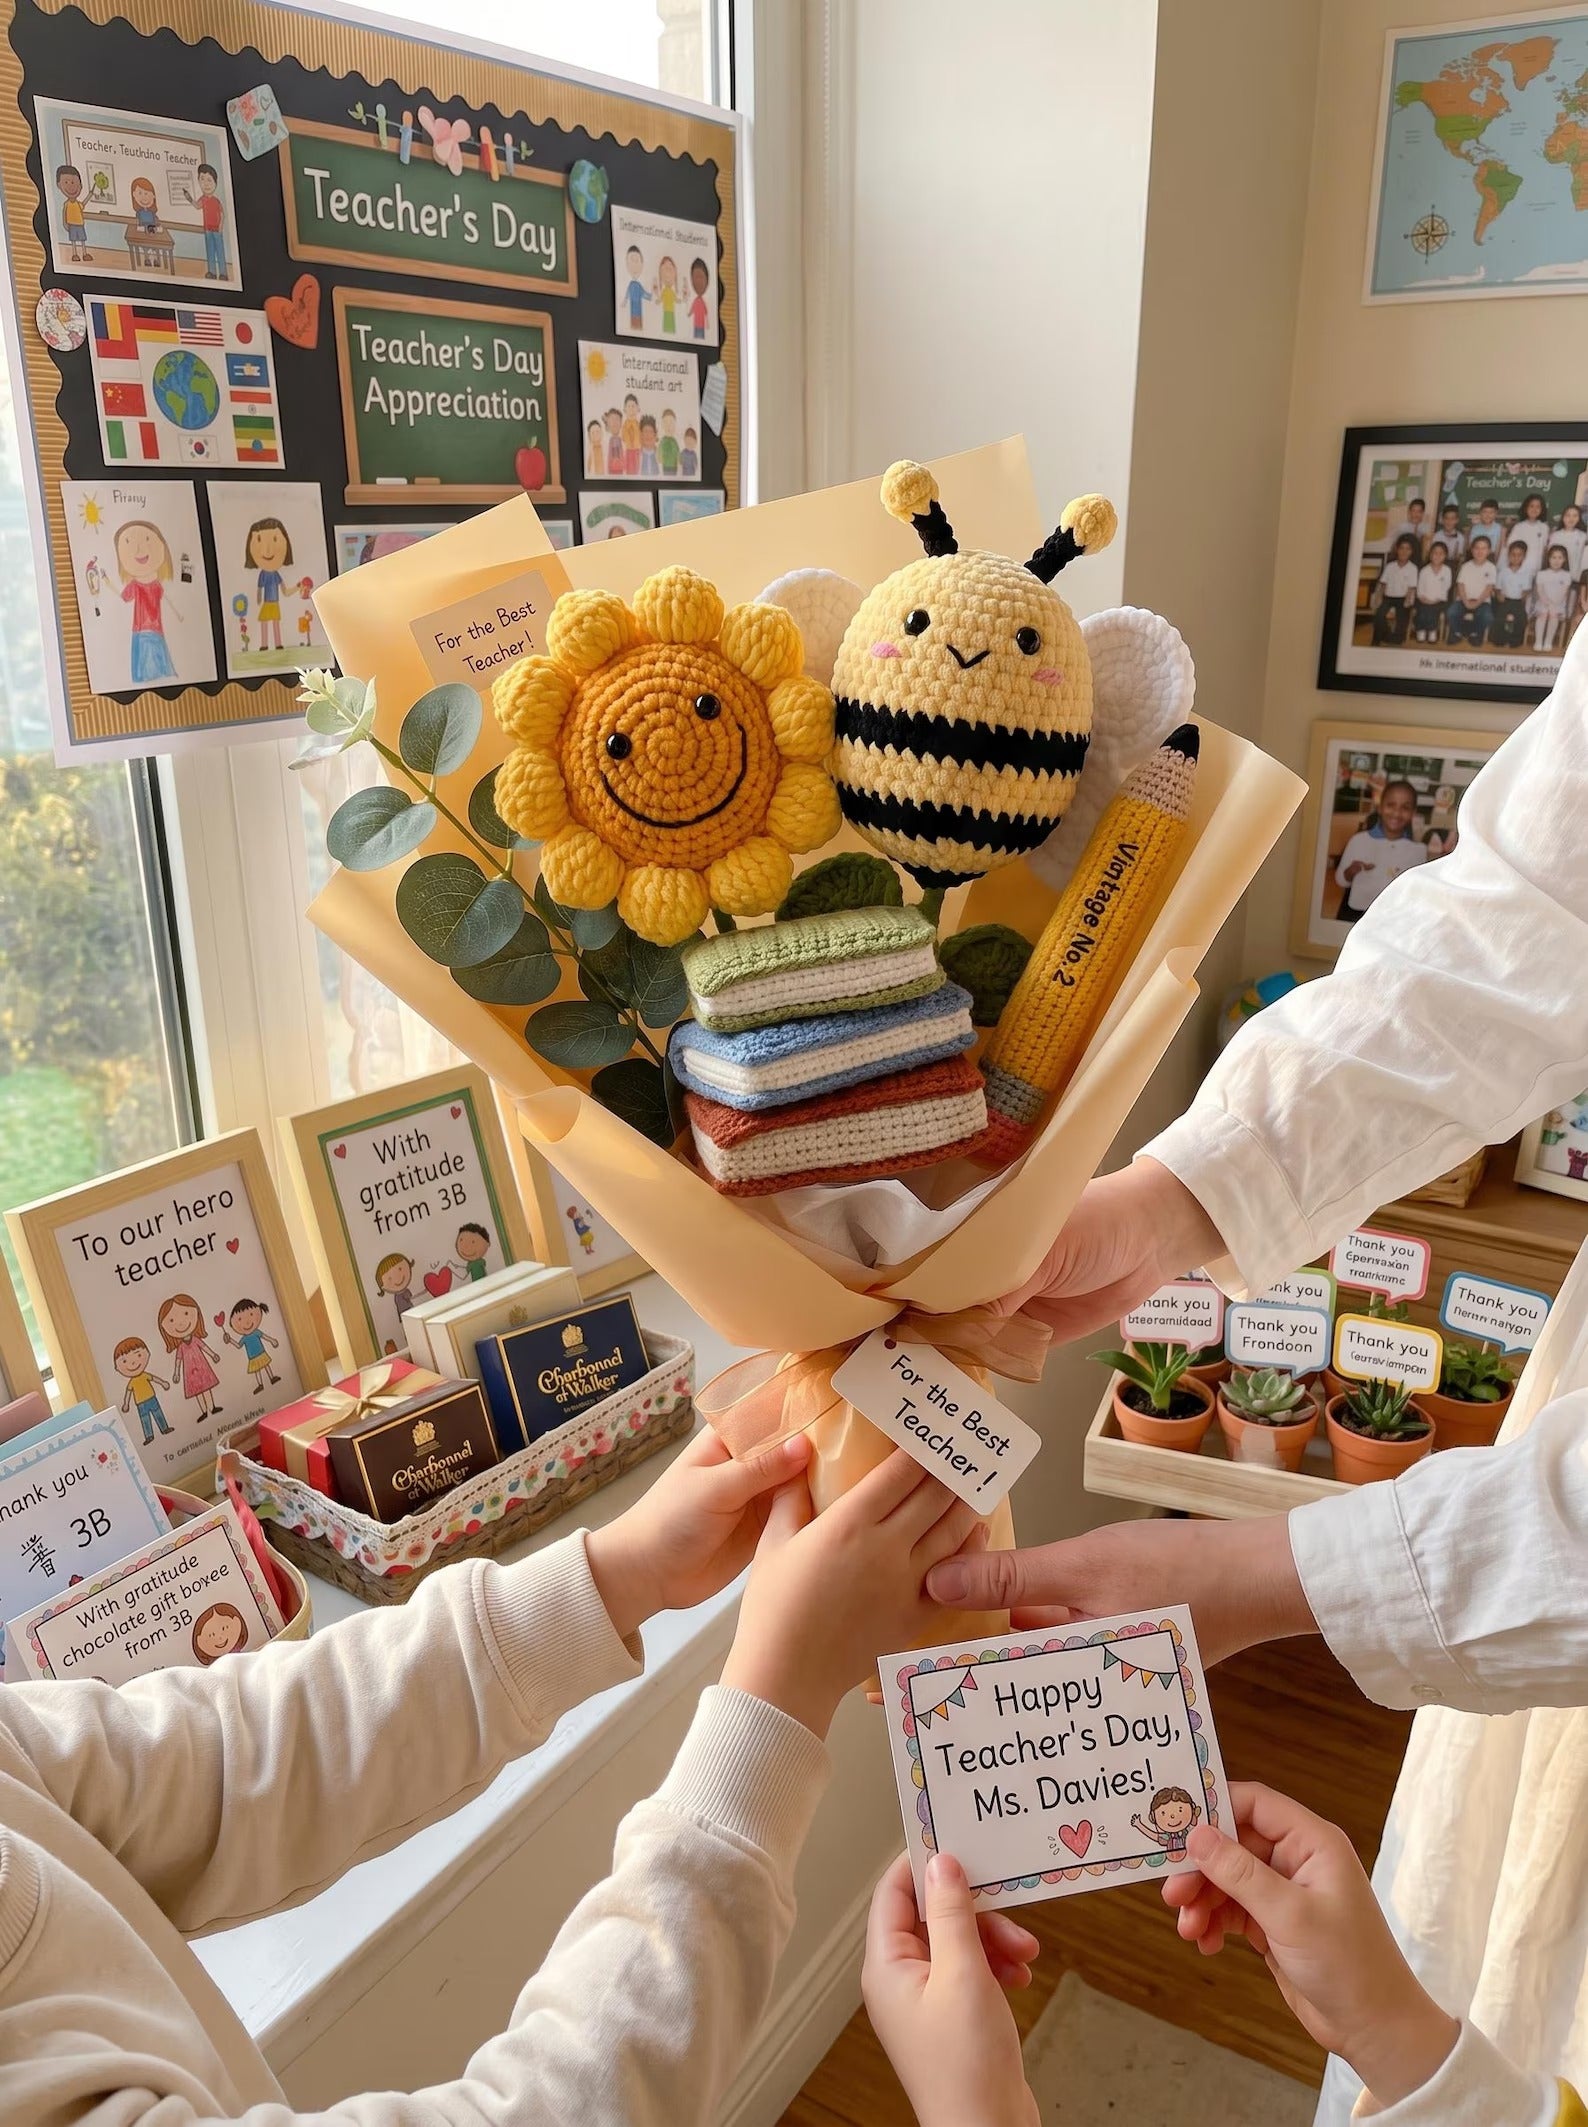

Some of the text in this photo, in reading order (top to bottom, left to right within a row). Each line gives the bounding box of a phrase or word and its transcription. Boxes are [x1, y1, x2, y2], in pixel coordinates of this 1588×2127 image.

[303, 167, 558, 272] Teacher's Day
[352, 323, 544, 387] Teacher's Day
[621, 352, 689, 375] International
[363, 376, 543, 427] Appreciation
[625, 374, 683, 393] student art
[1526, 475, 1552, 492] Day
[433, 601, 537, 654] For the Best
[372, 1127, 432, 1166] With
[358, 1151, 467, 1213] gratitude
[71, 1189, 235, 1262] To our hero
[372, 1182, 468, 1236] from 3B
[114, 1231, 218, 1287] teacher
[1348, 1234, 1415, 1257] Thank you
[1143, 1296, 1211, 1313] hank you
[1295, 1286, 1323, 1299] you
[1458, 1286, 1505, 1311] Thank
[1507, 1303, 1539, 1320] you
[1237, 1316, 1318, 1337] Thank you
[1346, 1329, 1429, 1358] Thank you
[564, 1373, 619, 1399] Walker
[890, 1353, 1011, 1457] For the Best
[52, 1465, 90, 1499] you
[391, 1439, 474, 1492] Charbonnel
[417, 1466, 470, 1495] Walker
[69, 1508, 112, 1548] 3B
[75, 1555, 200, 1629] With gratitude
[62, 1611, 148, 1668] chocolate
[150, 1591, 180, 1622] gift
[124, 1608, 194, 1660] from 3B
[993, 1675, 1103, 1717] Happy
[934, 1713, 1181, 1777] Teacher's Day,
[972, 1757, 1156, 1823] Ms. Davies!
